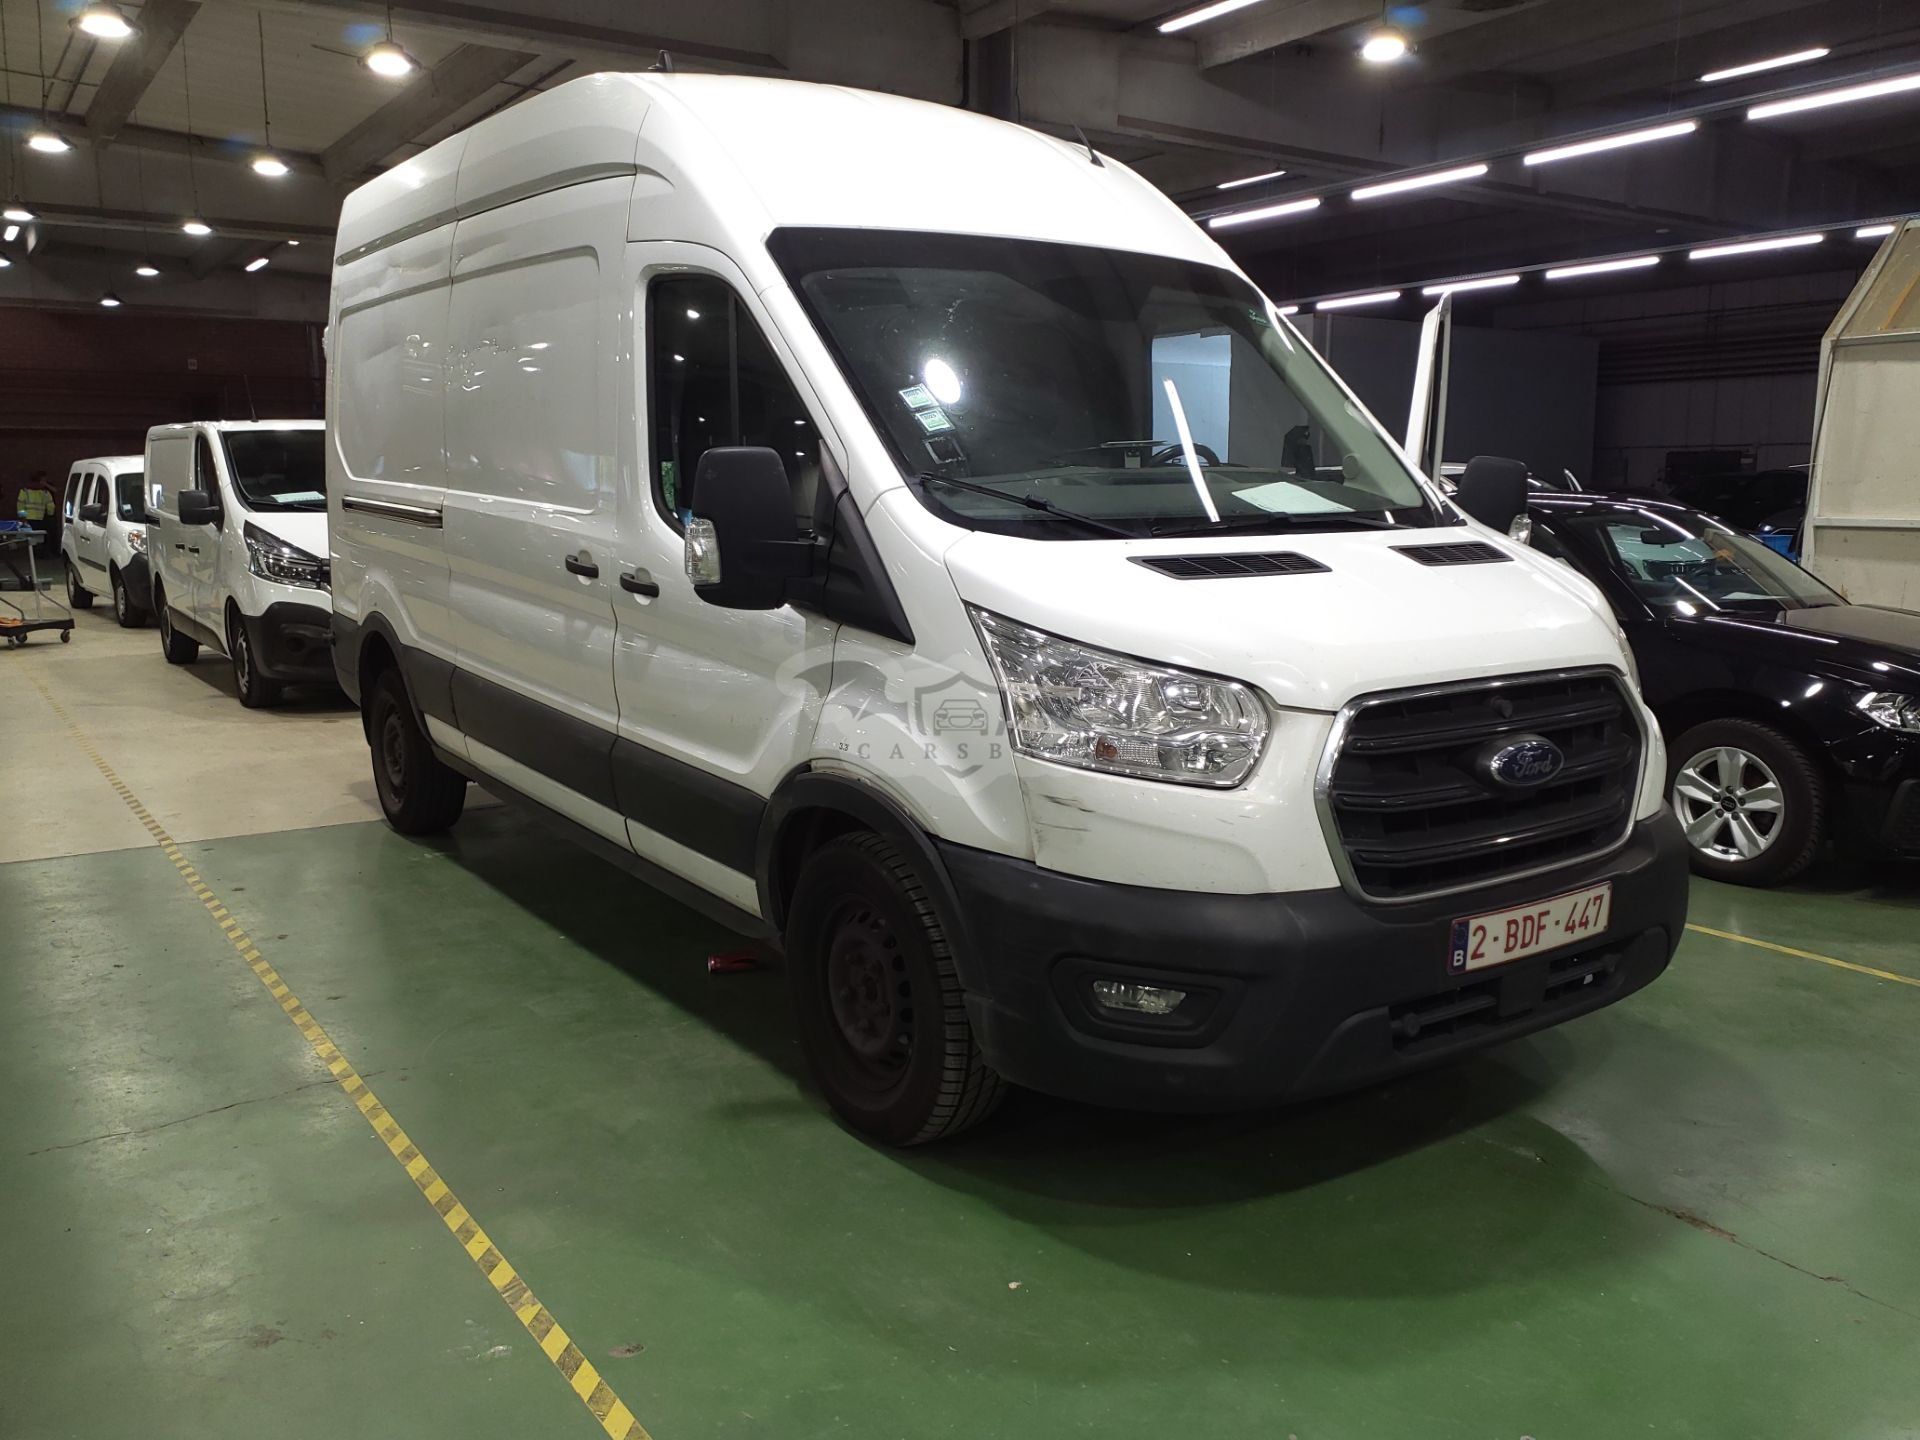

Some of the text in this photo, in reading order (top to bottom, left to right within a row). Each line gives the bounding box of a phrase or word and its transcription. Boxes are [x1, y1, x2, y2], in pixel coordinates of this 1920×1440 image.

[1512, 749, 1552, 777] Ford
[1453, 895, 1604, 967] B 2-BDF-447
